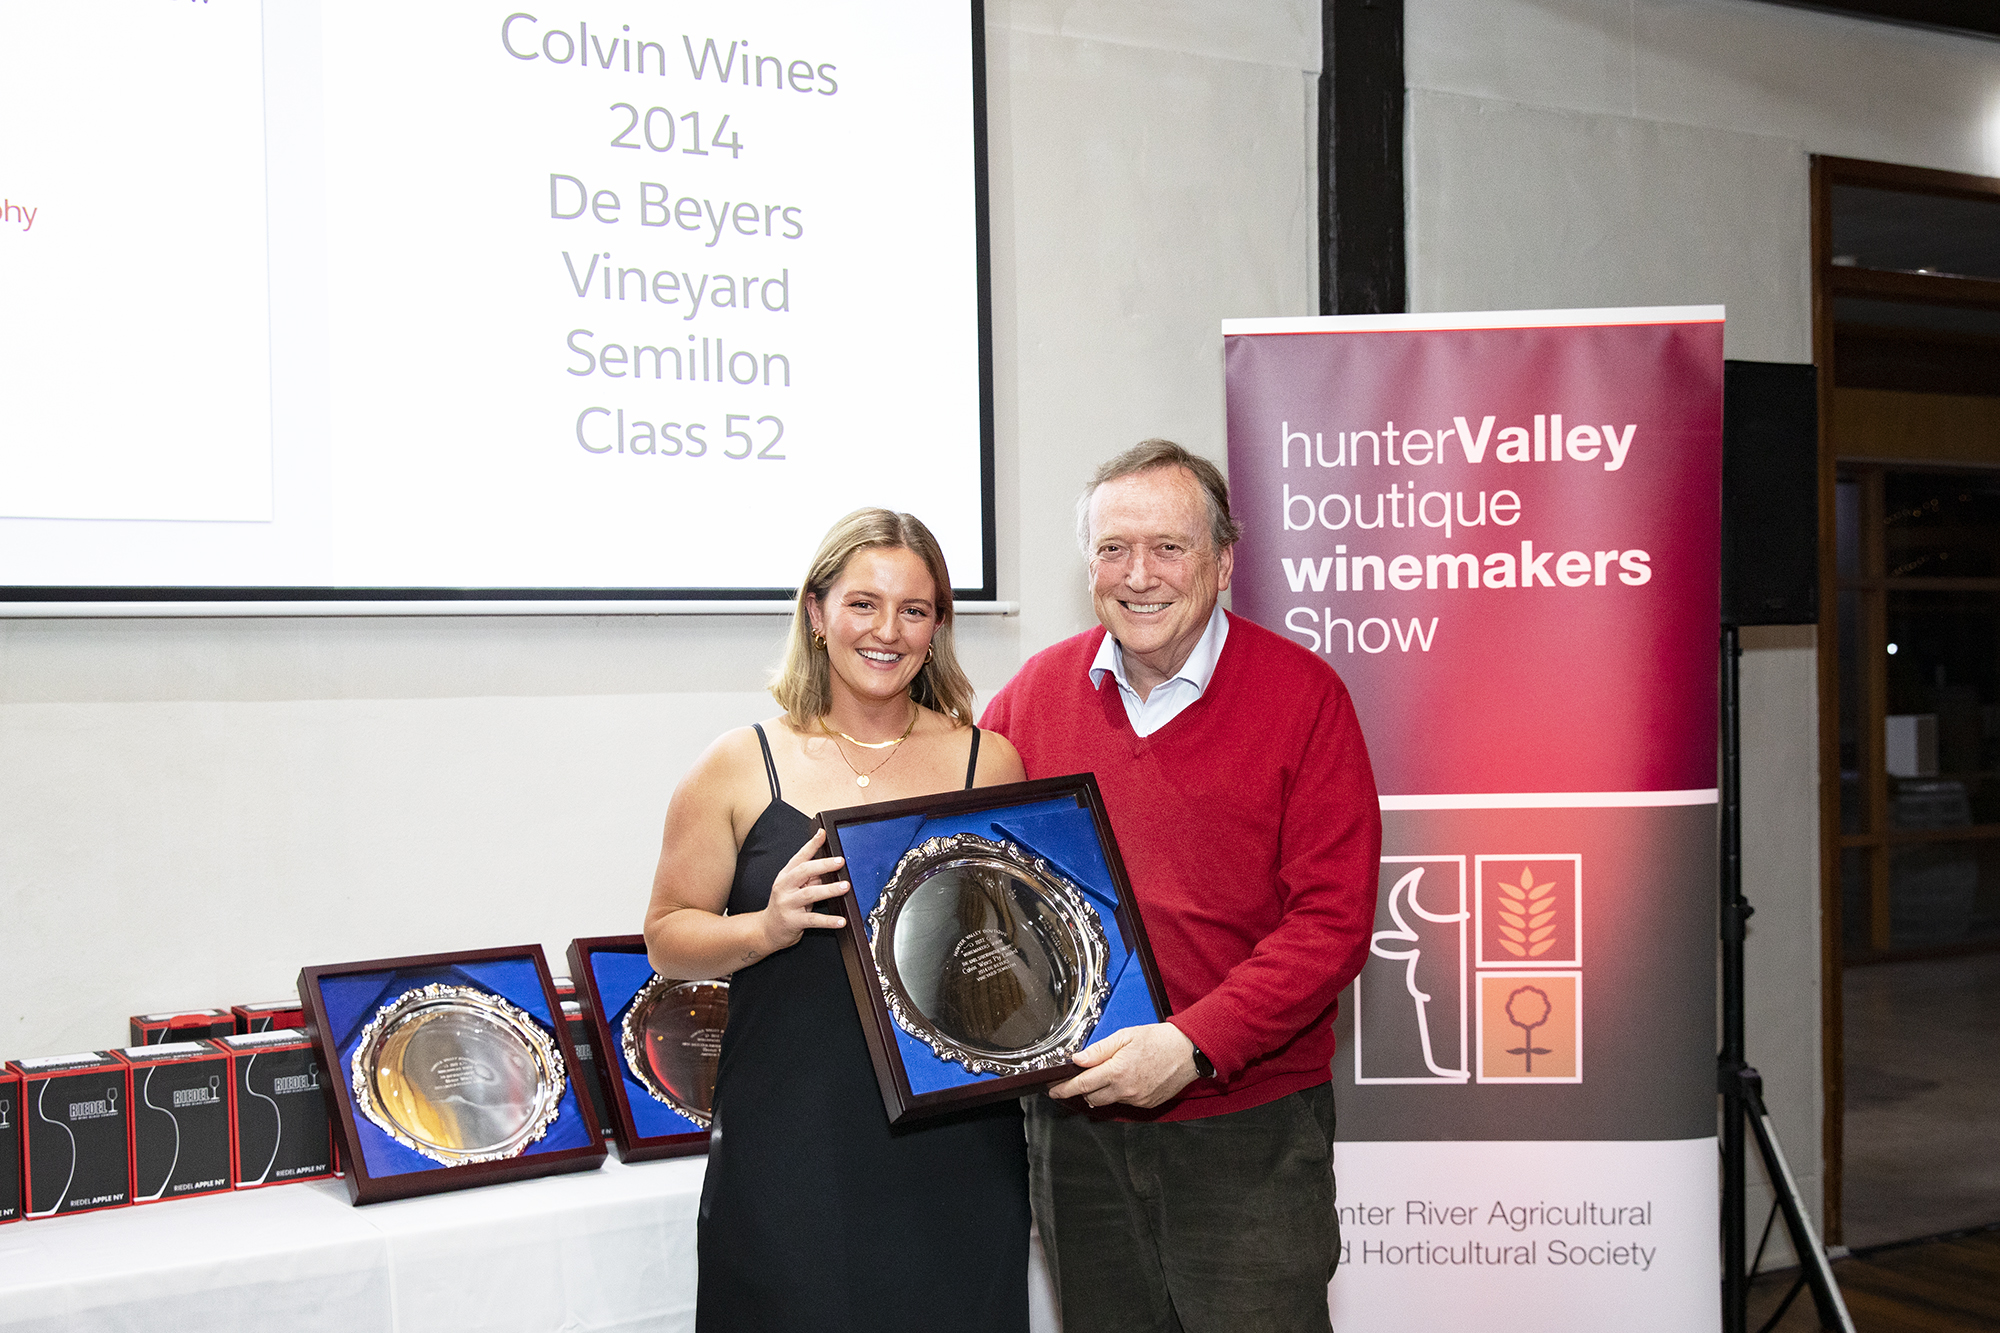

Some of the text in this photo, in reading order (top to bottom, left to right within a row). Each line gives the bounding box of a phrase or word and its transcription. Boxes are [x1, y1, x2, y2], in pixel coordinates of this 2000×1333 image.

[501, 12, 839, 97] Colvin Wines
[609, 102, 744, 160] 2014
[0, 198, 38, 232] hy
[550, 173, 804, 248] De Beyers
[561, 251, 790, 321] Vineyard
[566, 328, 791, 387] Semillon
[576, 406, 786, 461] Class 52
[1280, 413, 1638, 472] hunterValley
[1282, 480, 1522, 538] boutique
[1280, 539, 1653, 593] winemakers
[1284, 606, 1440, 654] Show
[173, 1087, 210, 1104] RIEDEL
[274, 1075, 310, 1092] RIEDEL
[69, 1100, 107, 1117] RIEDEL
[173, 1178, 226, 1192] RIEDEL APPLE NY
[276, 1164, 326, 1177] RIEDEL APPLE NY
[3, 1208, 15, 1217] NY
[70, 1193, 124, 1208] RIEDEL APPLE NY
[1339, 1200, 1652, 1232] nter River Agricultural
[1363, 1240, 1537, 1265] Horticultural
[1547, 1240, 1656, 1272] Society
